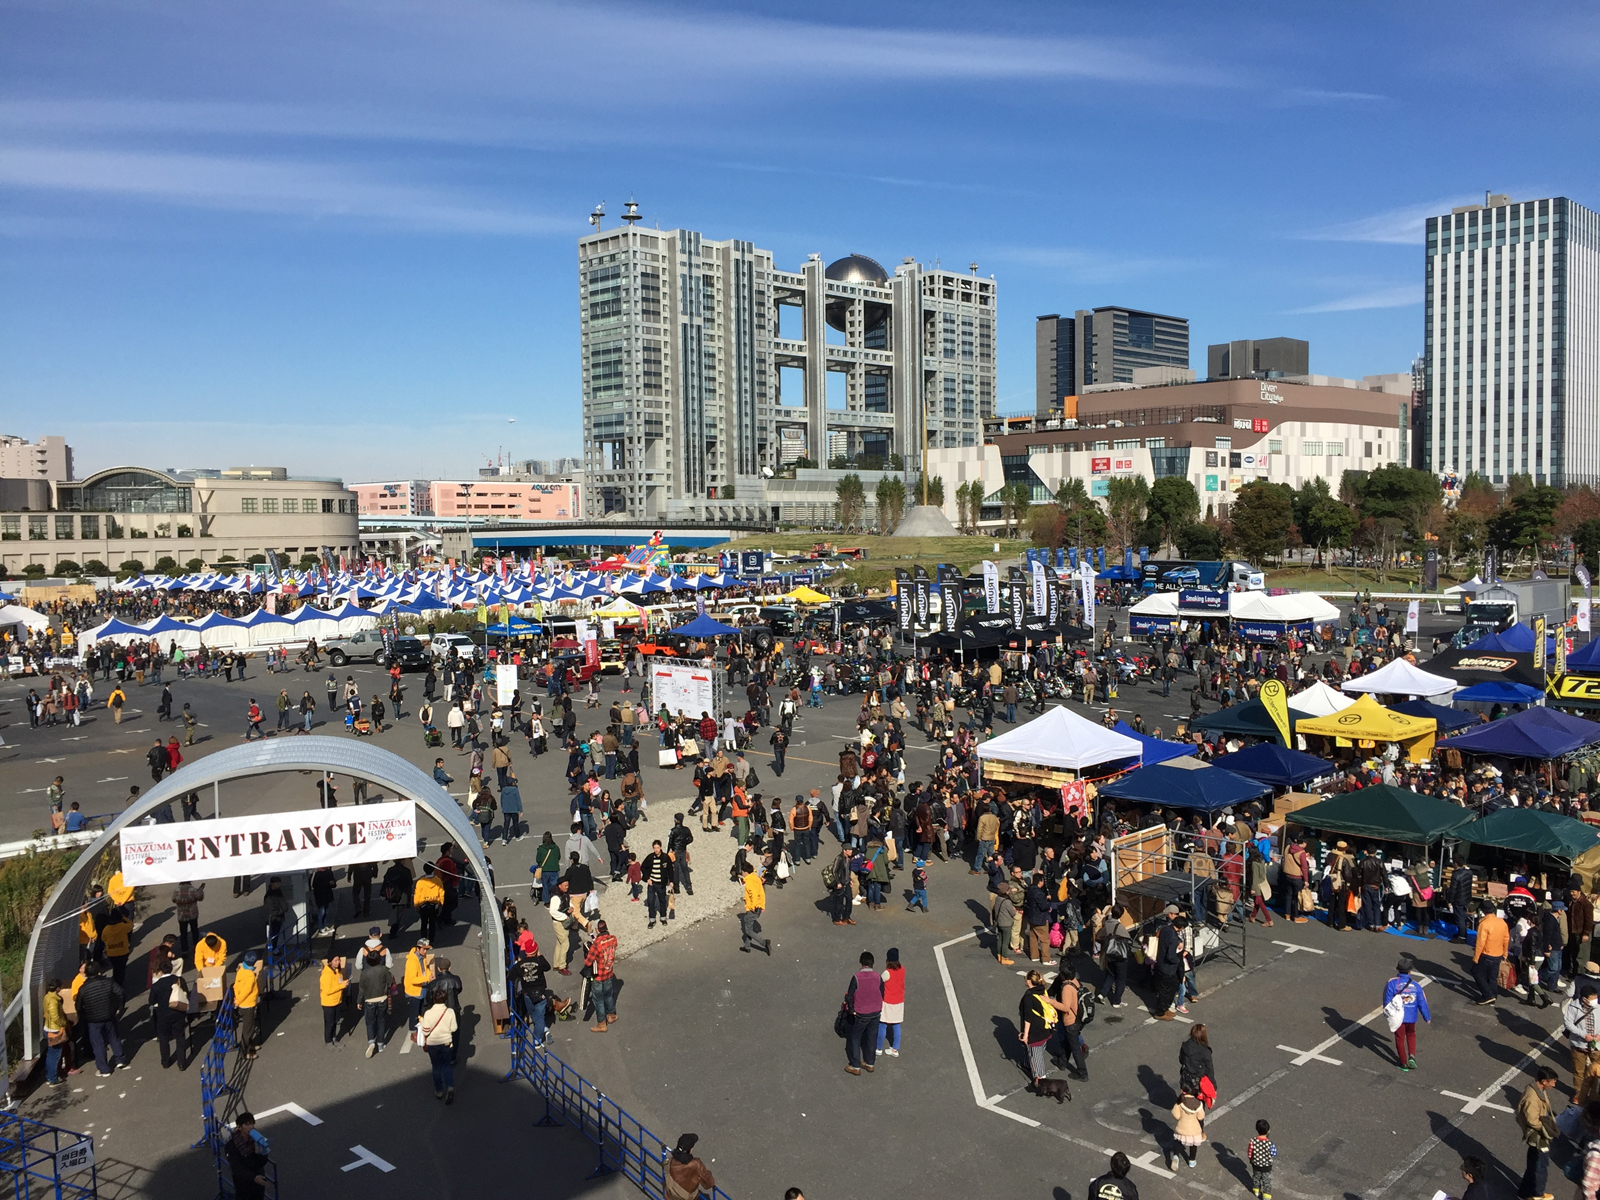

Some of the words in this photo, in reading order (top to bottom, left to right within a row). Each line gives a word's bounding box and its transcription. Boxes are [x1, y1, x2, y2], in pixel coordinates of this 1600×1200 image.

[1260, 382, 1278, 393] Diver
[1185, 594, 1204, 604] Smoking
[1205, 595, 1221, 605] Lounge
[1260, 628, 1277, 637] Lounge
[368, 819, 412, 831] INAZUMA
[368, 829, 391, 837] FESTIVAL
[175, 821, 366, 863] ENTRANCE
[124, 843, 173, 855] INAZUMA
[124, 852, 151, 861] FESTIVAL
[61, 1147, 87, 1161] 当日券
[60, 1157, 87, 1170] 入場口
